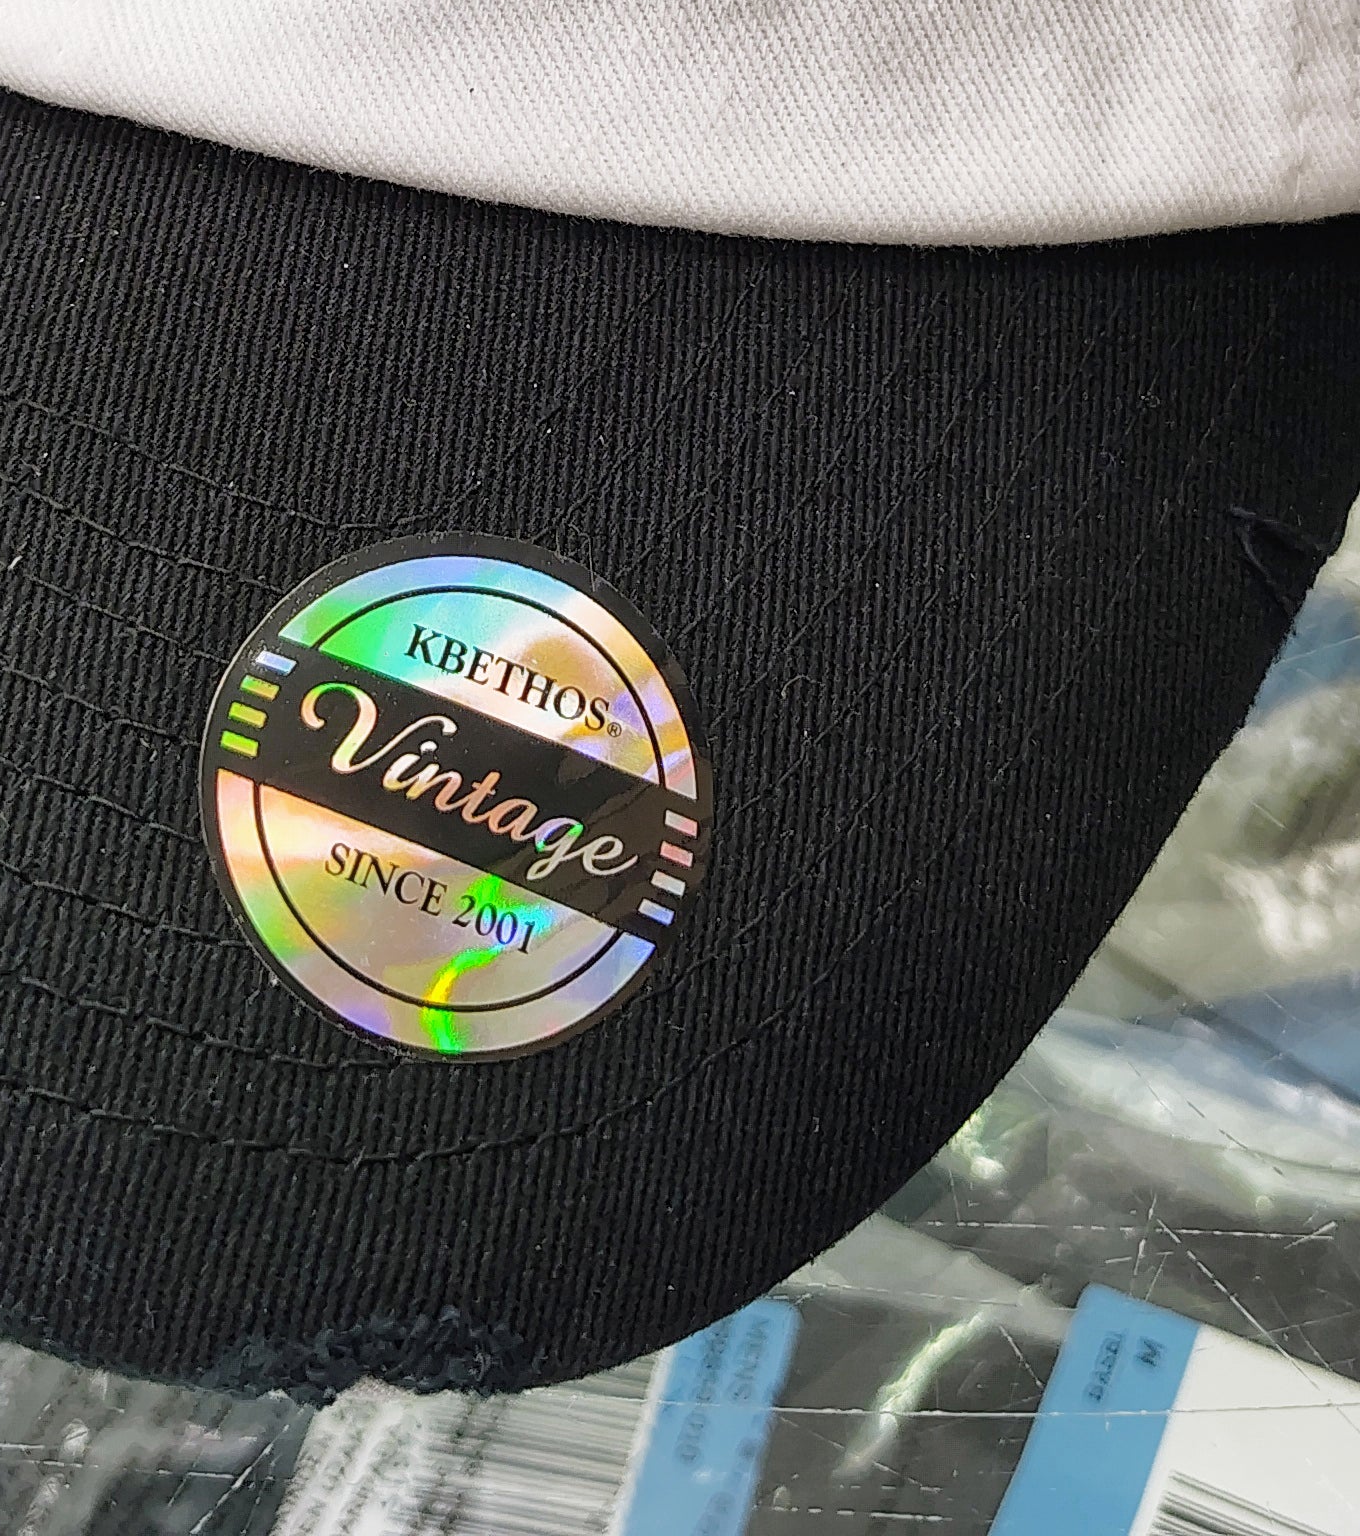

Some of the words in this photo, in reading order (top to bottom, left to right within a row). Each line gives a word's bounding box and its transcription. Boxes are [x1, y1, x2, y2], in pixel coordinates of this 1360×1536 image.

[300, 682, 639, 882] Vintage
[324, 842, 448, 916] SINCE
[451, 894, 537, 955] 2001
